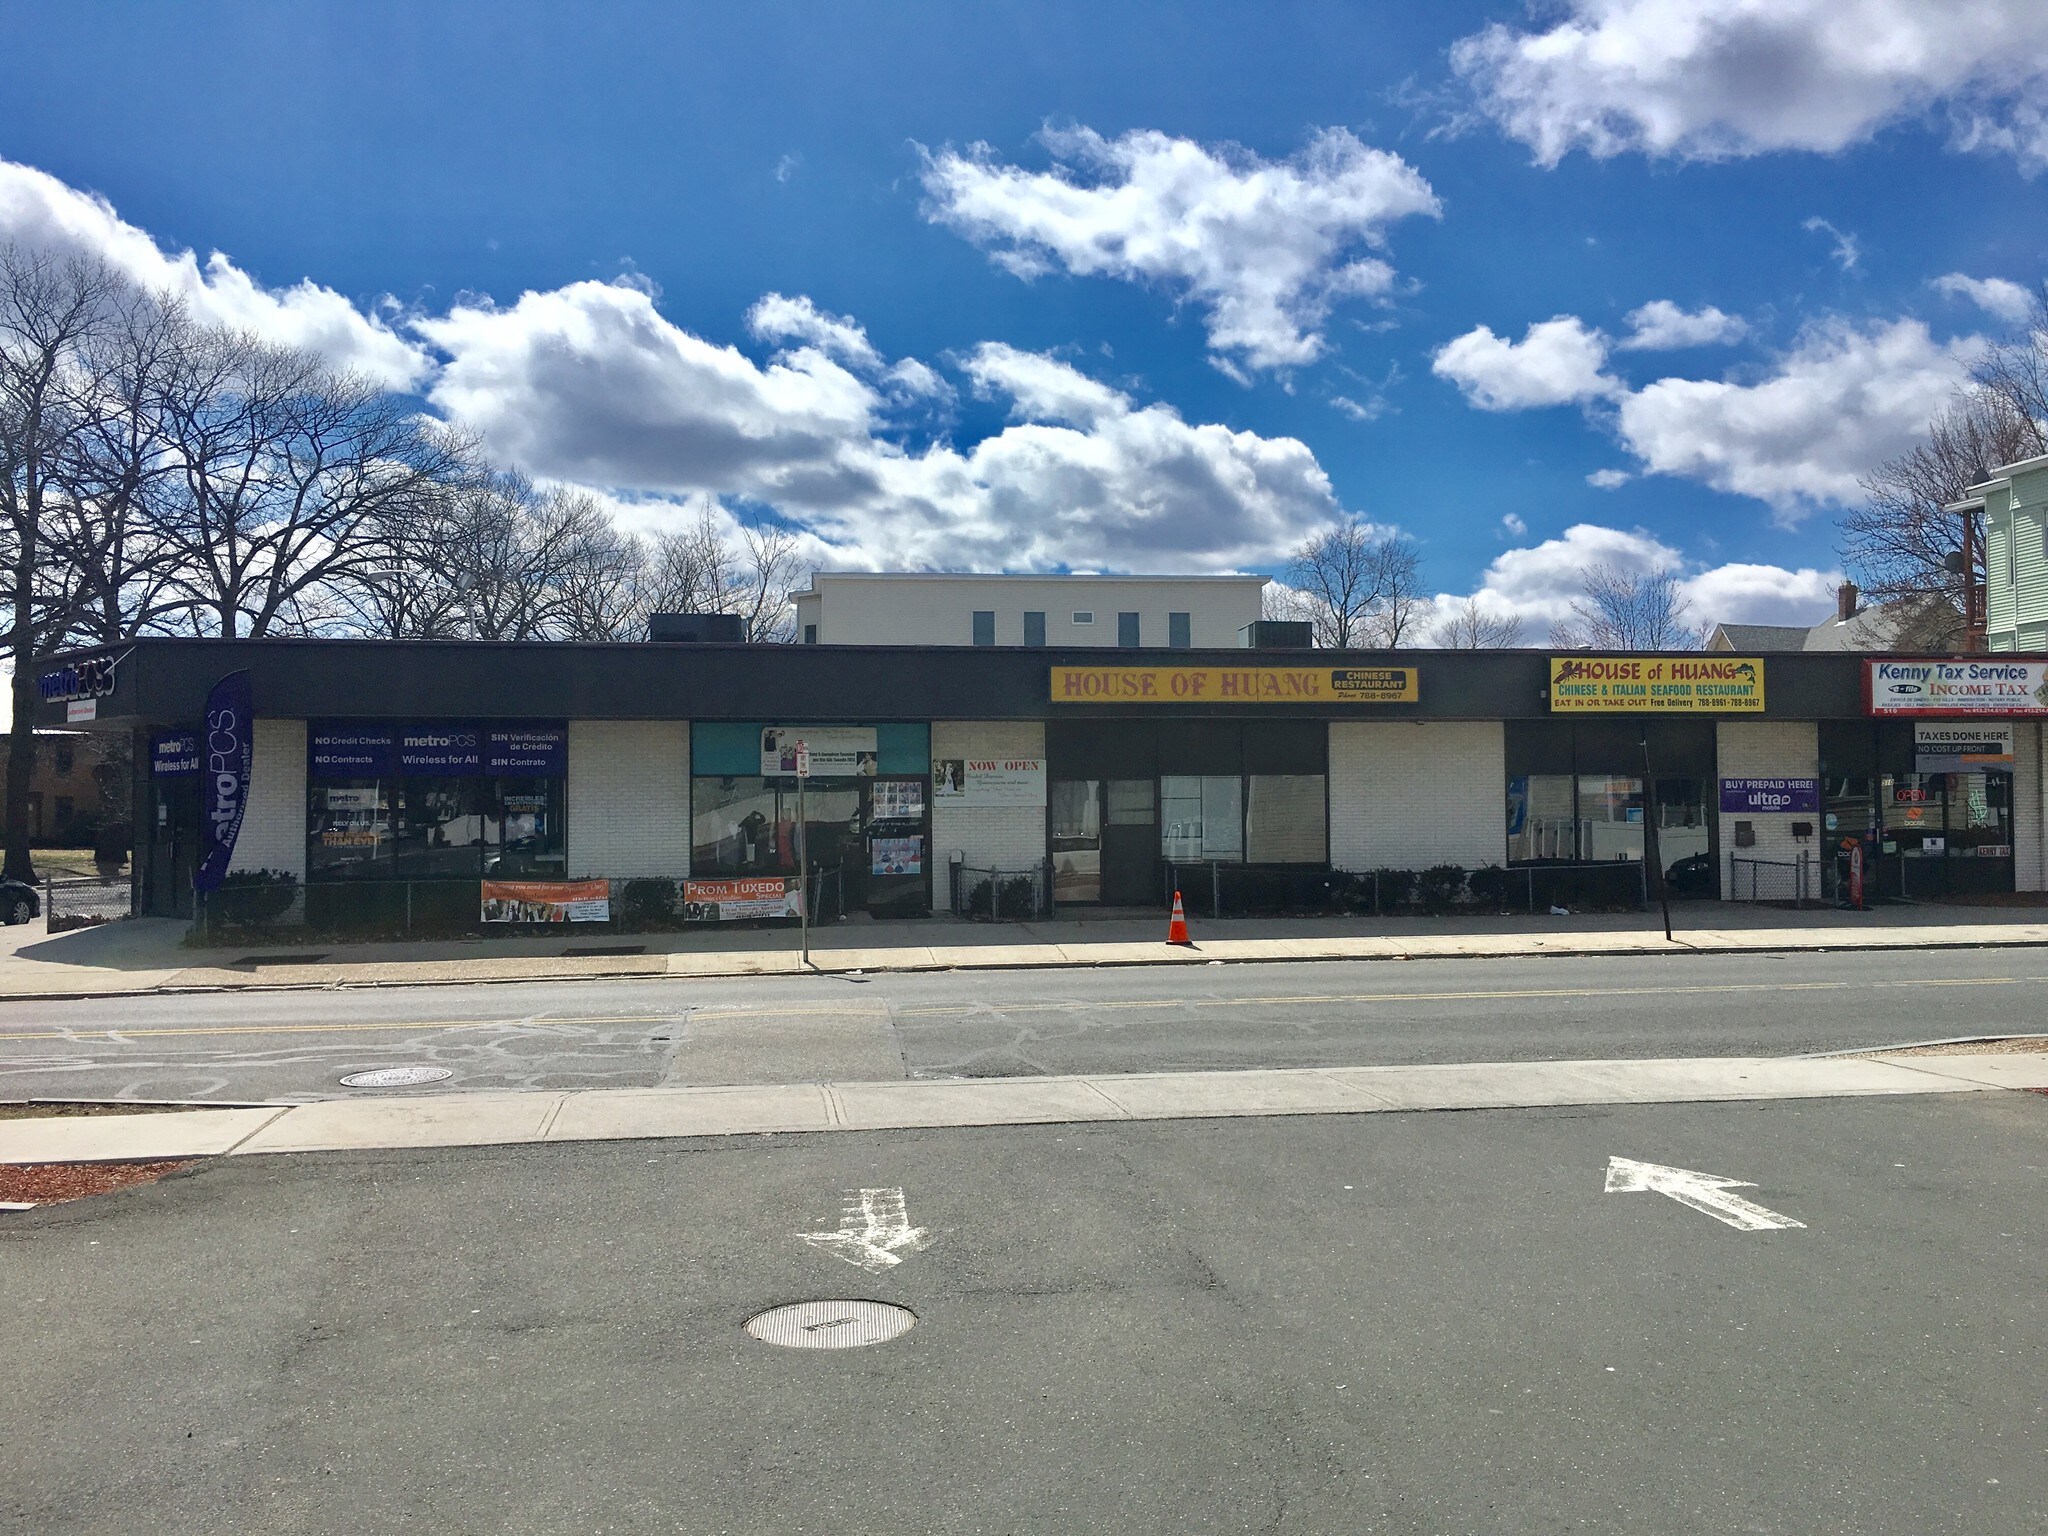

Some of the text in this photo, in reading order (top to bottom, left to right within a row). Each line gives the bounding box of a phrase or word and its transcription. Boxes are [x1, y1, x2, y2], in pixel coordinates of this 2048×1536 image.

[1346, 672, 1392, 680] CHINESE
[1578, 662, 1737, 680] HOUSE of HUANG
[1878, 664, 2028, 683] Kenny Tax Service
[1063, 671, 1320, 697] HOUSE OF HUANG
[1334, 680, 1404, 689] RESTAURANT
[1558, 684, 1754, 696] CHINESE & ITALIAN SEAFOOD RESTAURANT
[1929, 683, 2030, 696] INCOME TAX
[1554, 699, 1572, 707] EAT
[1575, 699, 1584, 707] IN
[1586, 699, 1600, 707] OR
[1603, 699, 1624, 707] TAKE
[1667, 699, 1693, 708] Delivery
[315, 737, 391, 745] NO Credit Checks
[404, 734, 476, 747] metroPCS
[510, 733, 559, 742] Verificación
[1918, 731, 2009, 741] TAXES DONE HERE
[1918, 745, 1930, 753] NO
[1931, 745, 1951, 753] COST
[154, 757, 199, 772] Wireless for All
[241, 742, 250, 781] Dealer
[402, 755, 478, 764] Wireless for All
[968, 761, 1039, 771] NOW OPEN
[1725, 780, 1813, 789] BUY PREPAID HERE!
[1748, 791, 1781, 805] ultra
[1896, 789, 1927, 801] OPEN
[323, 837, 352, 846] THAN
[687, 881, 785, 895] PROM TUXEDO
[756, 892, 782, 900] SPECIAL
